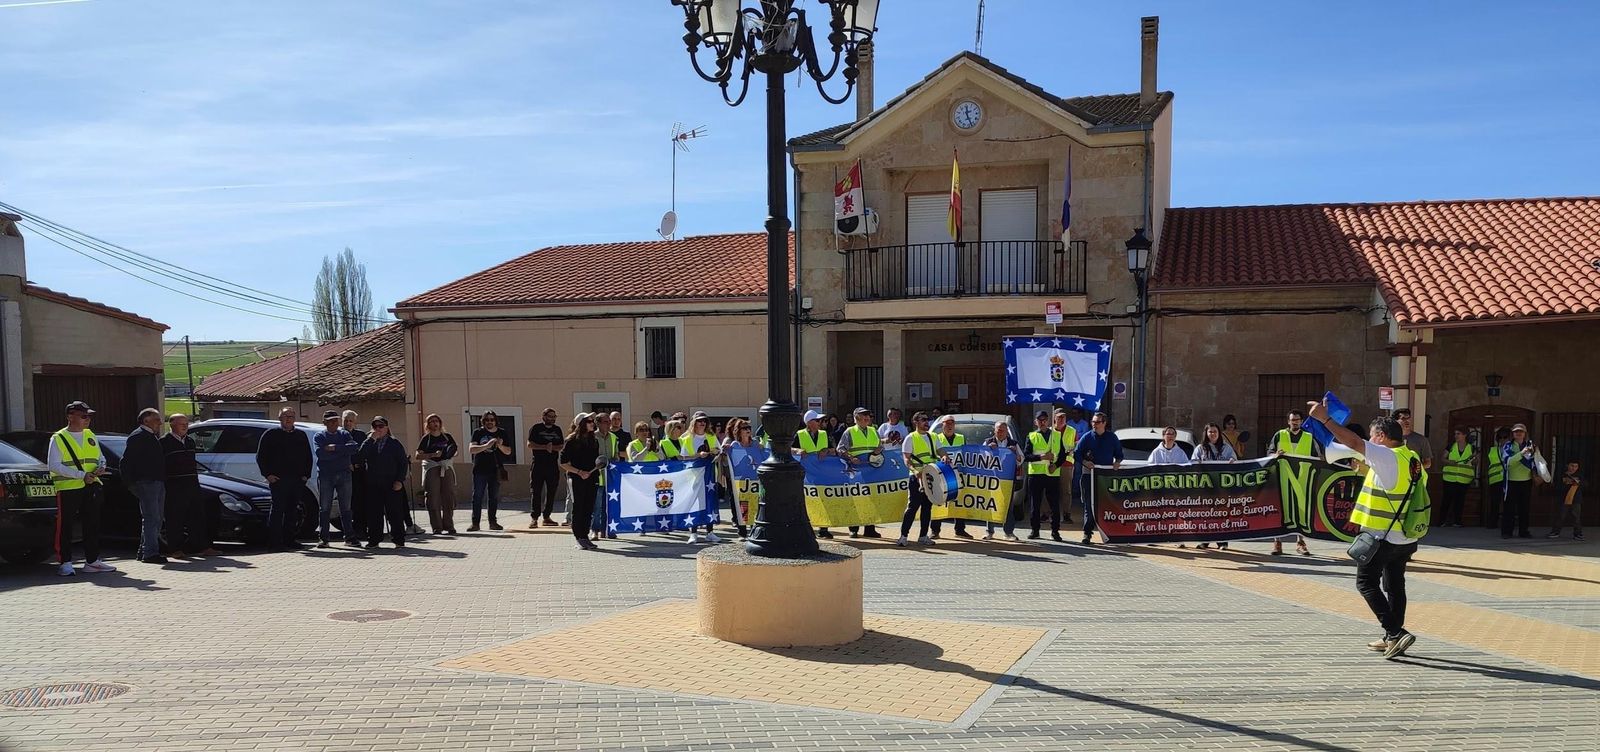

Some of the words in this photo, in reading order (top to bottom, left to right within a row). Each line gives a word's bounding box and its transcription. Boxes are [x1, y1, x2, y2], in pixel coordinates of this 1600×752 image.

[928, 343, 953, 352] CASA
[959, 342, 1002, 352] CONSIST
[824, 483, 871, 497] cuida
[877, 480, 909, 494] nue
[1109, 474, 1213, 492] JAMBRINA
[1221, 470, 1268, 487] DICE
[1123, 499, 1140, 509] Con
[1142, 496, 1175, 508] nuestra
[1176, 495, 1201, 507] salud
[1214, 497, 1227, 506] se
[1104, 511, 1116, 520] No
[1118, 511, 1161, 524] queremos
[1162, 511, 1177, 519] ser
[1179, 508, 1228, 519] estercolero
[1230, 507, 1242, 516] de
[1135, 522, 1145, 532] Ni
[1158, 522, 1167, 531] tu
[1169, 520, 1197, 533] pueblo
[1198, 520, 1206, 530] ni
[1208, 522, 1219, 530] en
[1220, 519, 1230, 529] el
